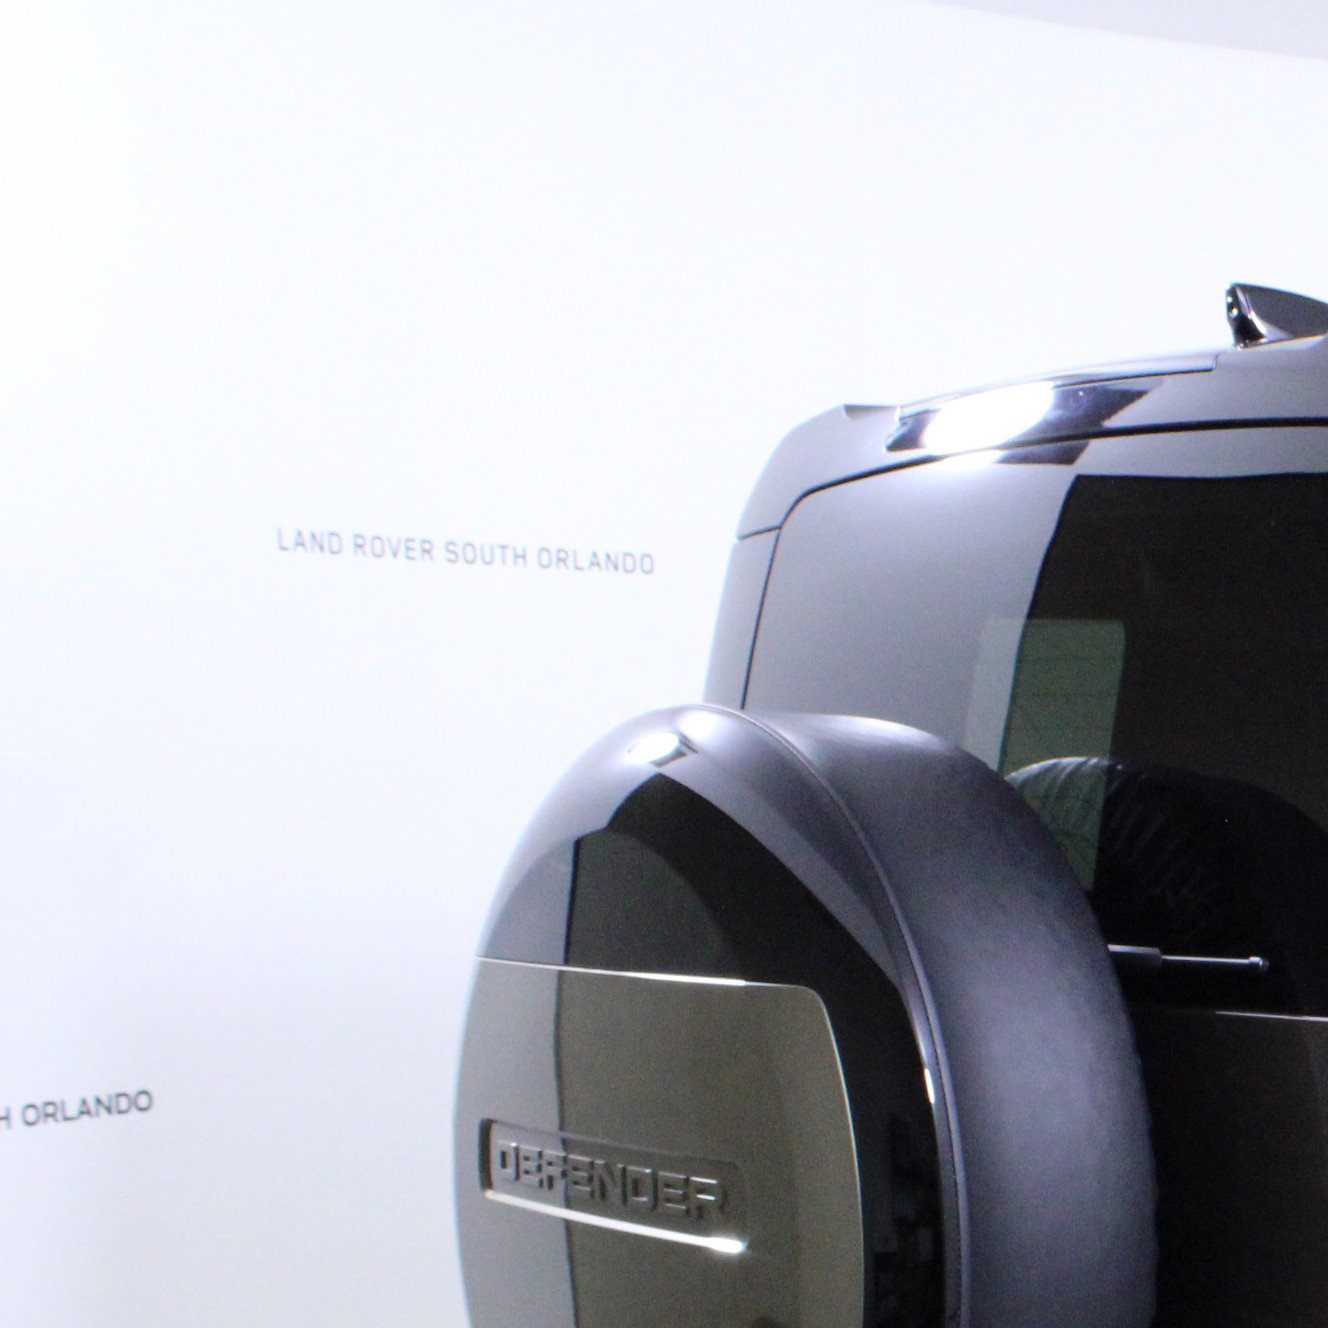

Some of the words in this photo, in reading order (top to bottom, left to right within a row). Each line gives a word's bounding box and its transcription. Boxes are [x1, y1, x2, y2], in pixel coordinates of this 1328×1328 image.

[277, 528, 343, 555] LAND
[352, 533, 435, 561] ROVER
[445, 540, 528, 568] SOUTH
[538, 547, 655, 575] ORLANDO
[21, 1089, 154, 1127] ORLANDO
[497, 1139, 729, 1221] DEFENDER
